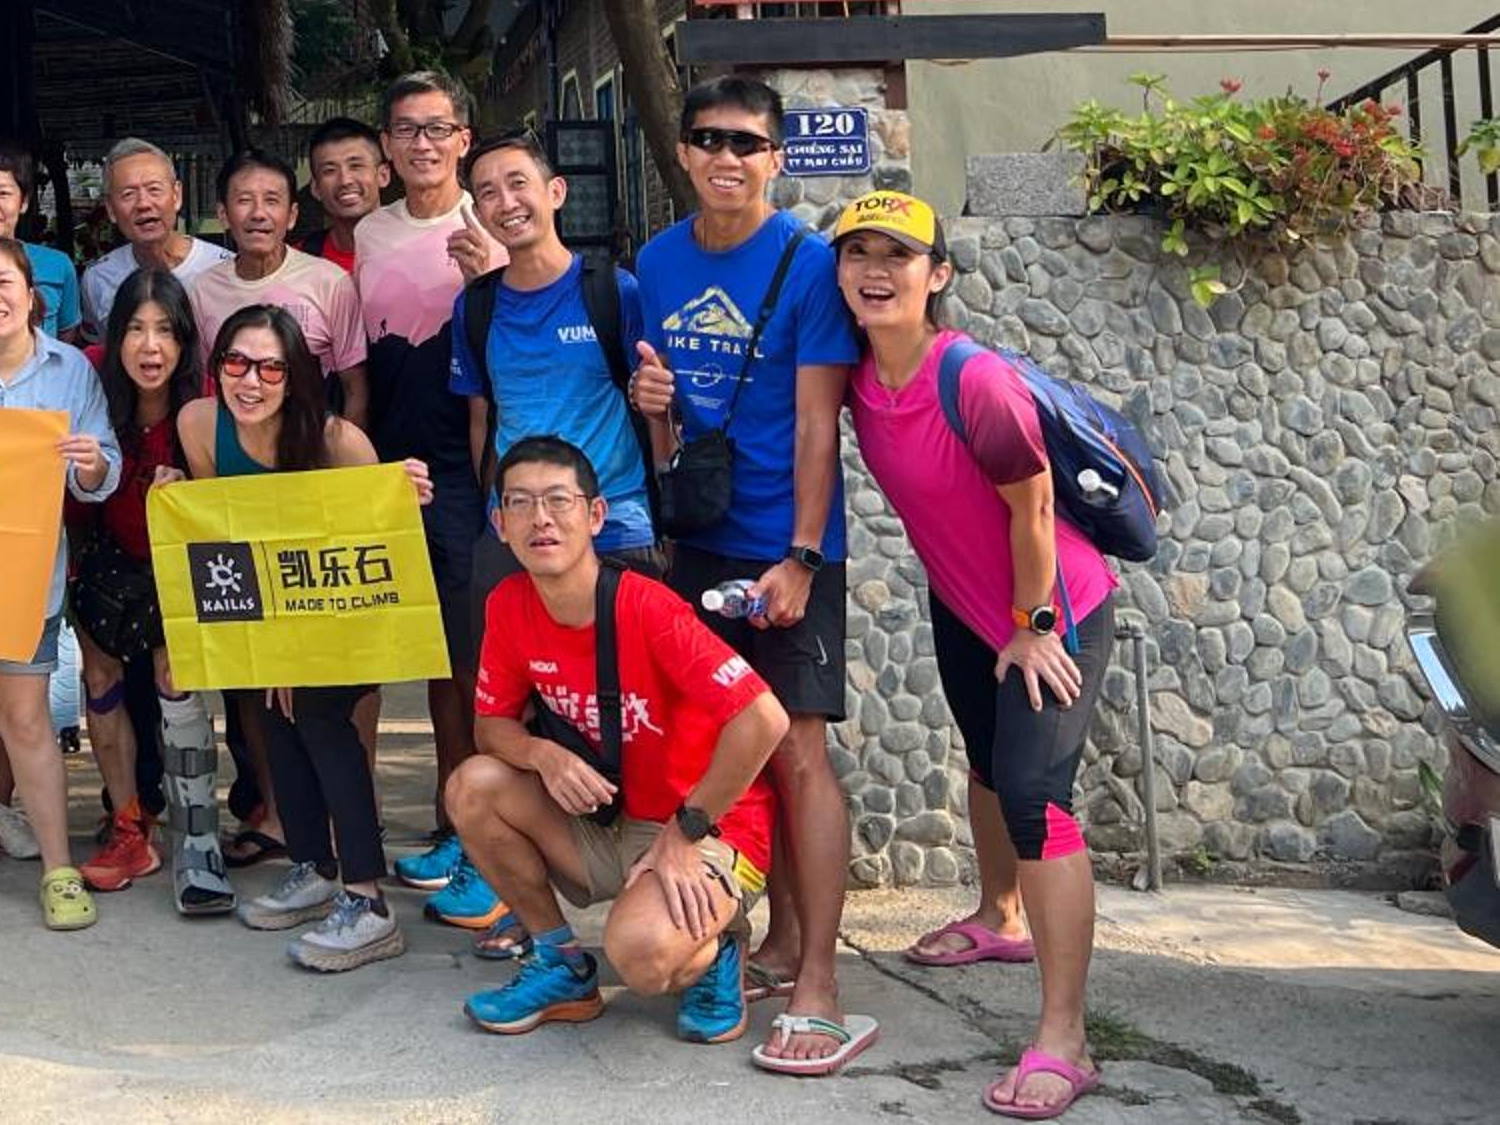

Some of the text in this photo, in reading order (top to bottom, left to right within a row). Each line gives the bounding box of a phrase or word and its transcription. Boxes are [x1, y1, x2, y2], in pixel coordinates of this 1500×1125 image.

[798, 113, 854, 135] 120
[277, 544, 393, 590] 凯乐石
[284, 591, 400, 613] MADE TO CLIMB
